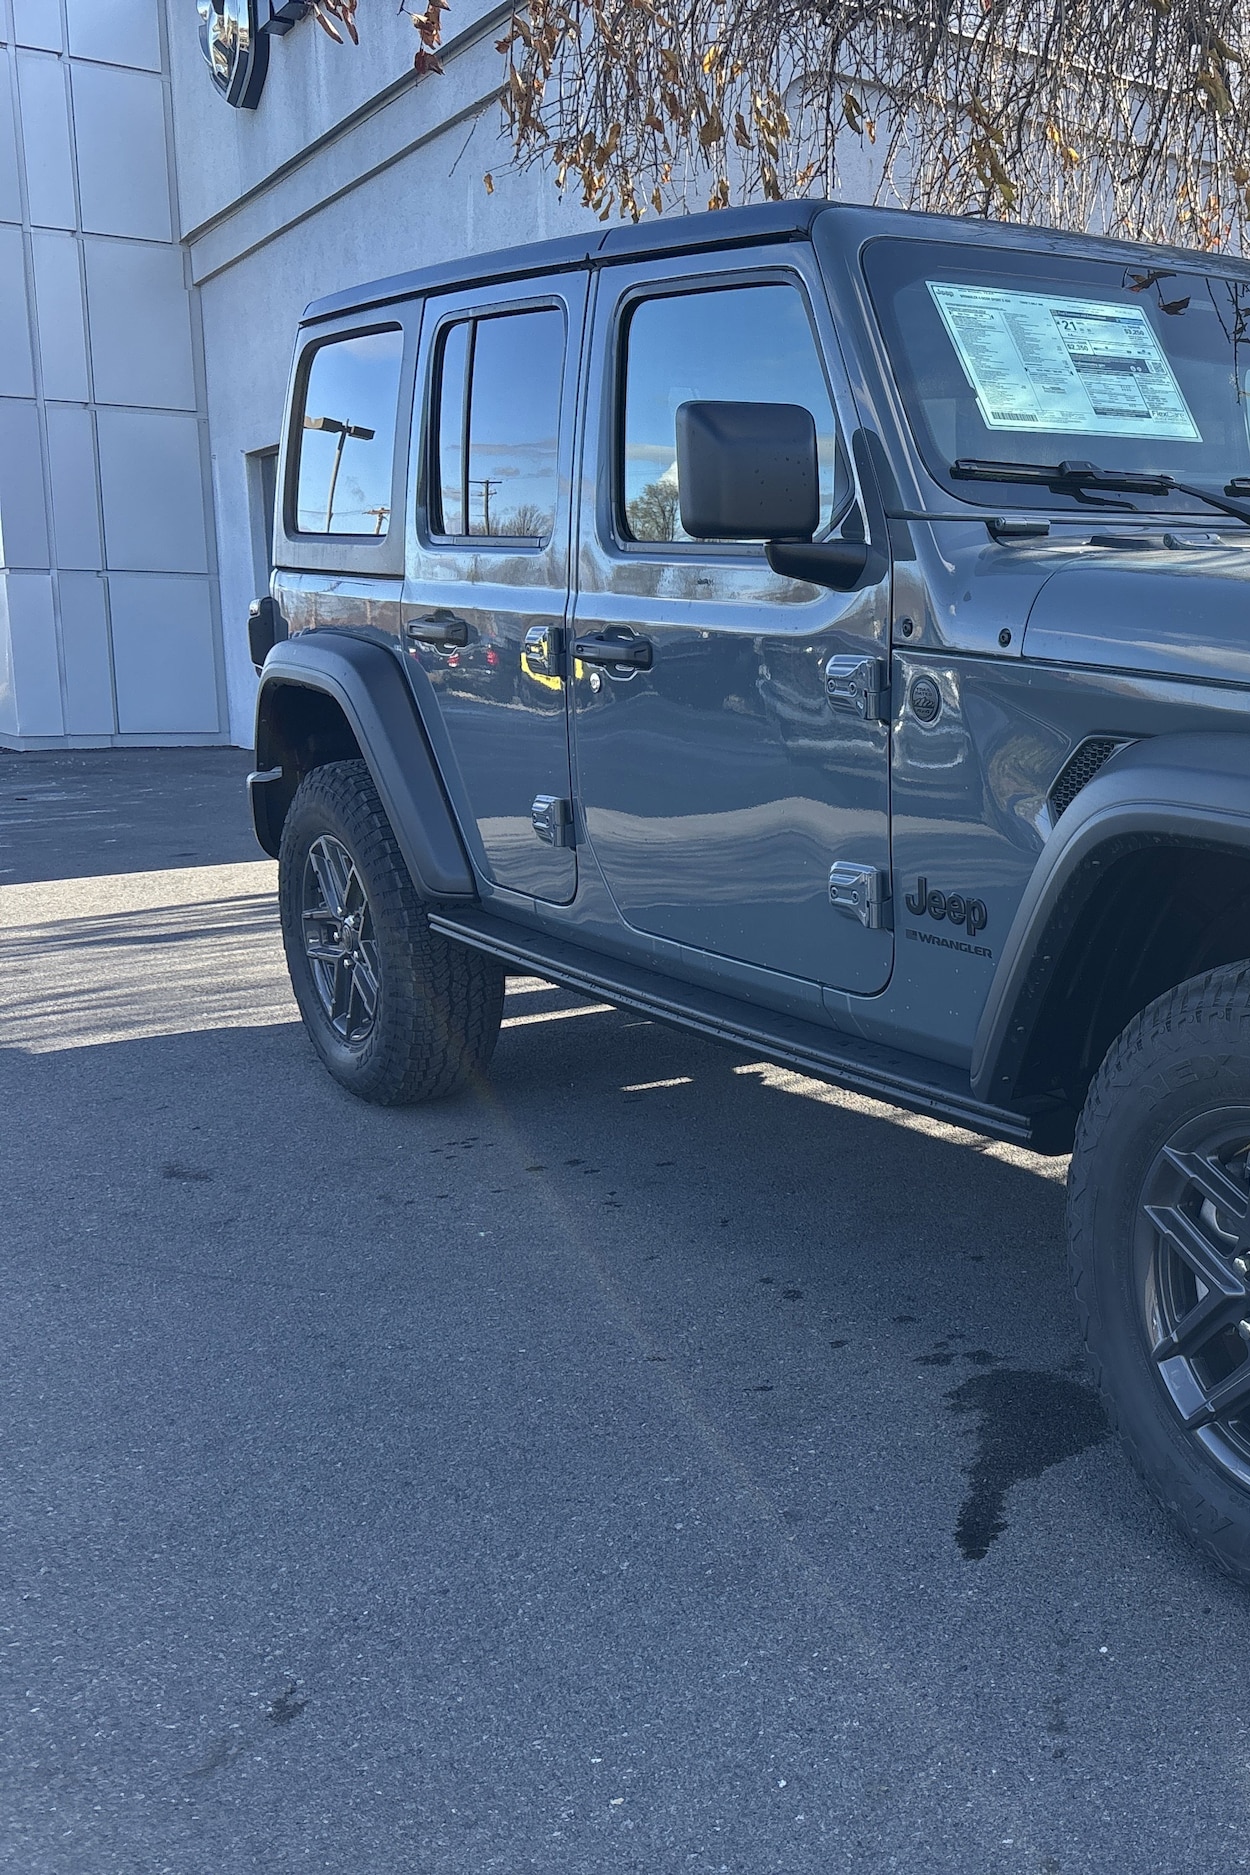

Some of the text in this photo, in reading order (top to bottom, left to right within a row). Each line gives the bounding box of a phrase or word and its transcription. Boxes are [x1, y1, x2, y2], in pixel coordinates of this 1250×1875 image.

[1061, 320, 1077, 331] 21
[905, 876, 987, 937] Jeep
[918, 931, 992, 959] WRANGLER
